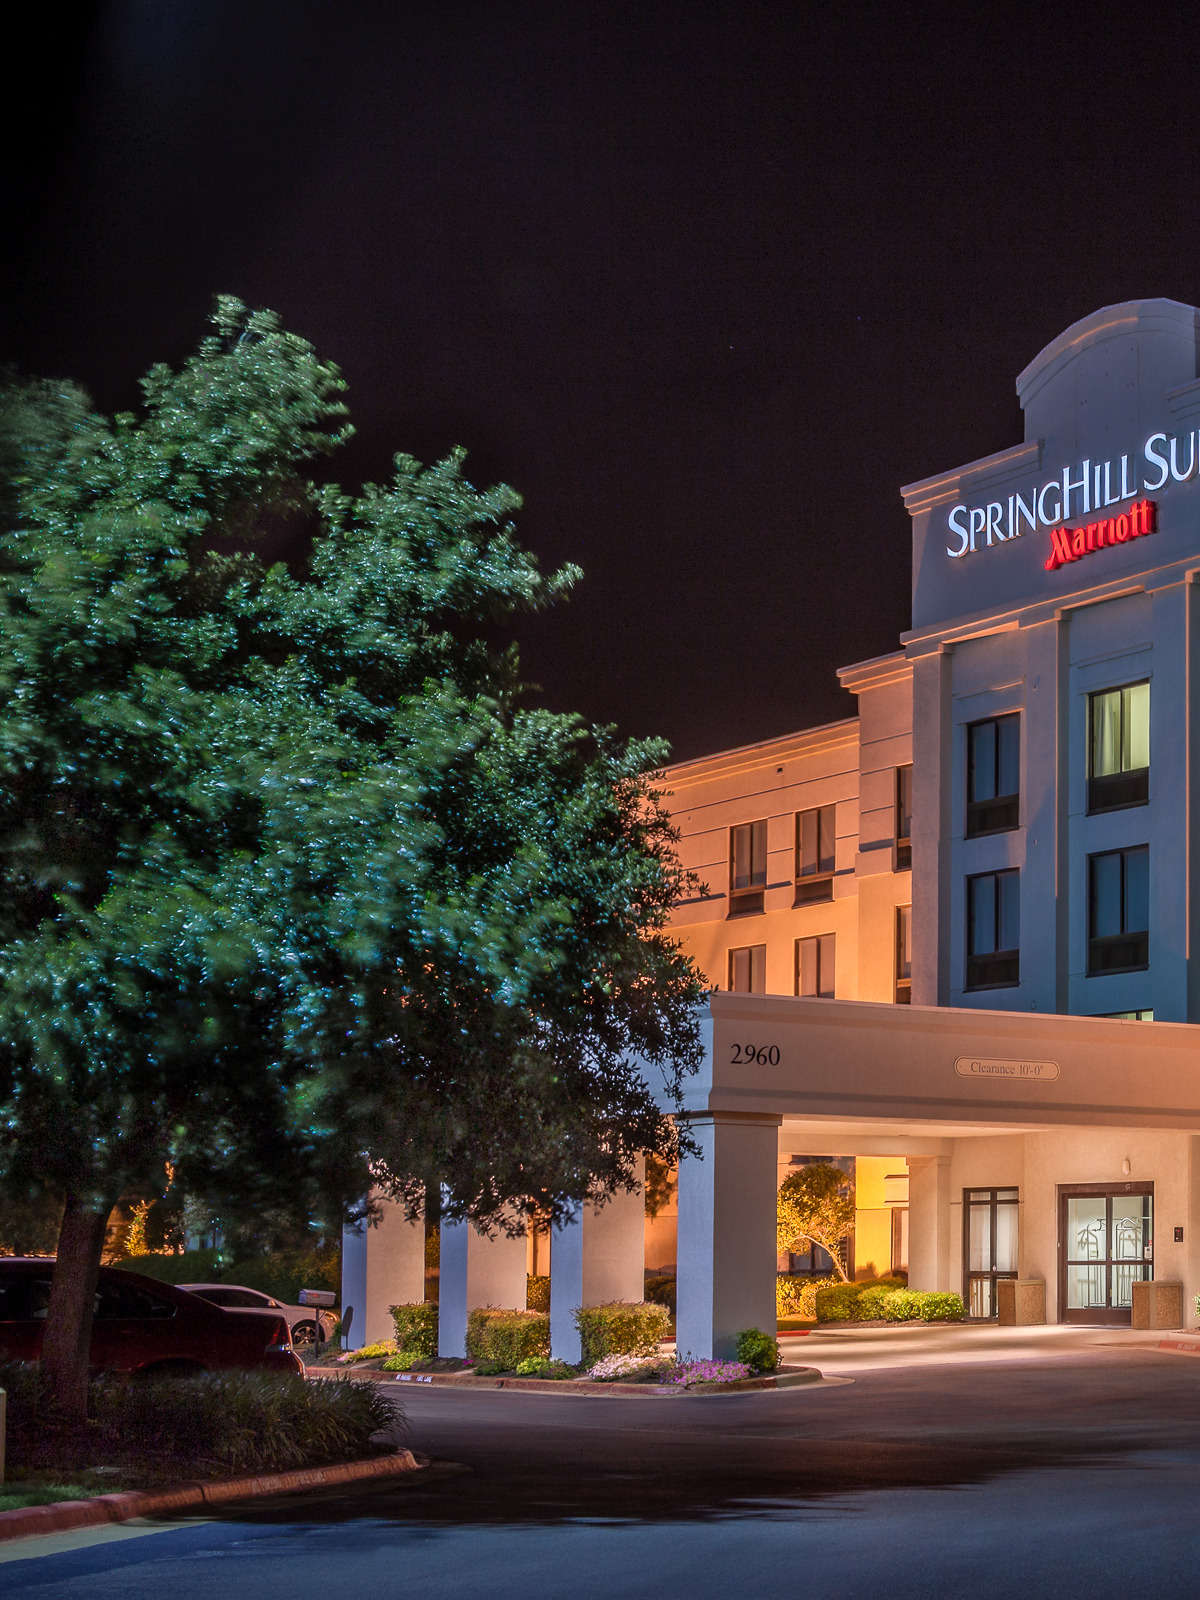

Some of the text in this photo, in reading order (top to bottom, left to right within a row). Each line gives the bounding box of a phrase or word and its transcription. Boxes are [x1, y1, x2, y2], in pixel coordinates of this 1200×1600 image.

[947, 454, 1138, 559] SPRINGHILL
[1044, 499, 1158, 570] Marriott
[730, 1043, 780, 1066] 2960
[970, 1061, 1015, 1075] Clearance
